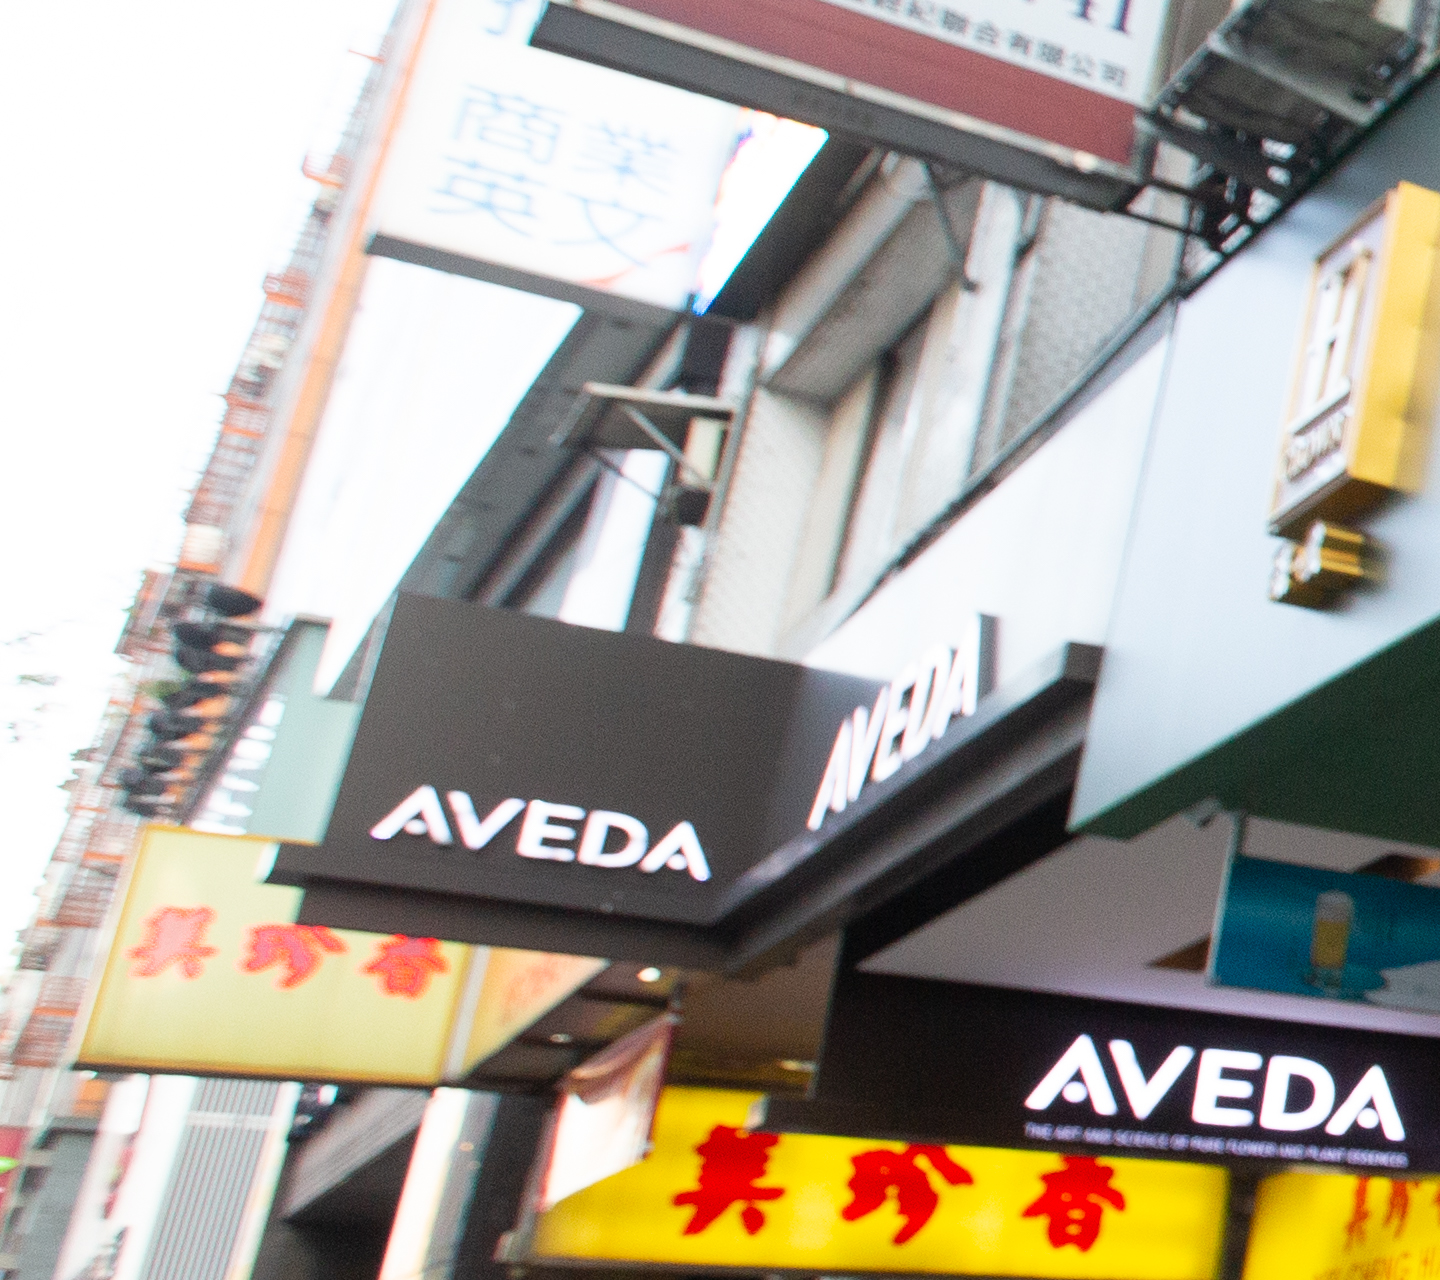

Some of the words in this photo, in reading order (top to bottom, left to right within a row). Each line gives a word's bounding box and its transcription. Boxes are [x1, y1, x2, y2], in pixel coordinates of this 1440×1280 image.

[425, 153, 664, 268] 英文
[808, 618, 983, 831] AVEDA
[370, 785, 713, 883] AVEDA
[1024, 1033, 1406, 1141] AVEDA
